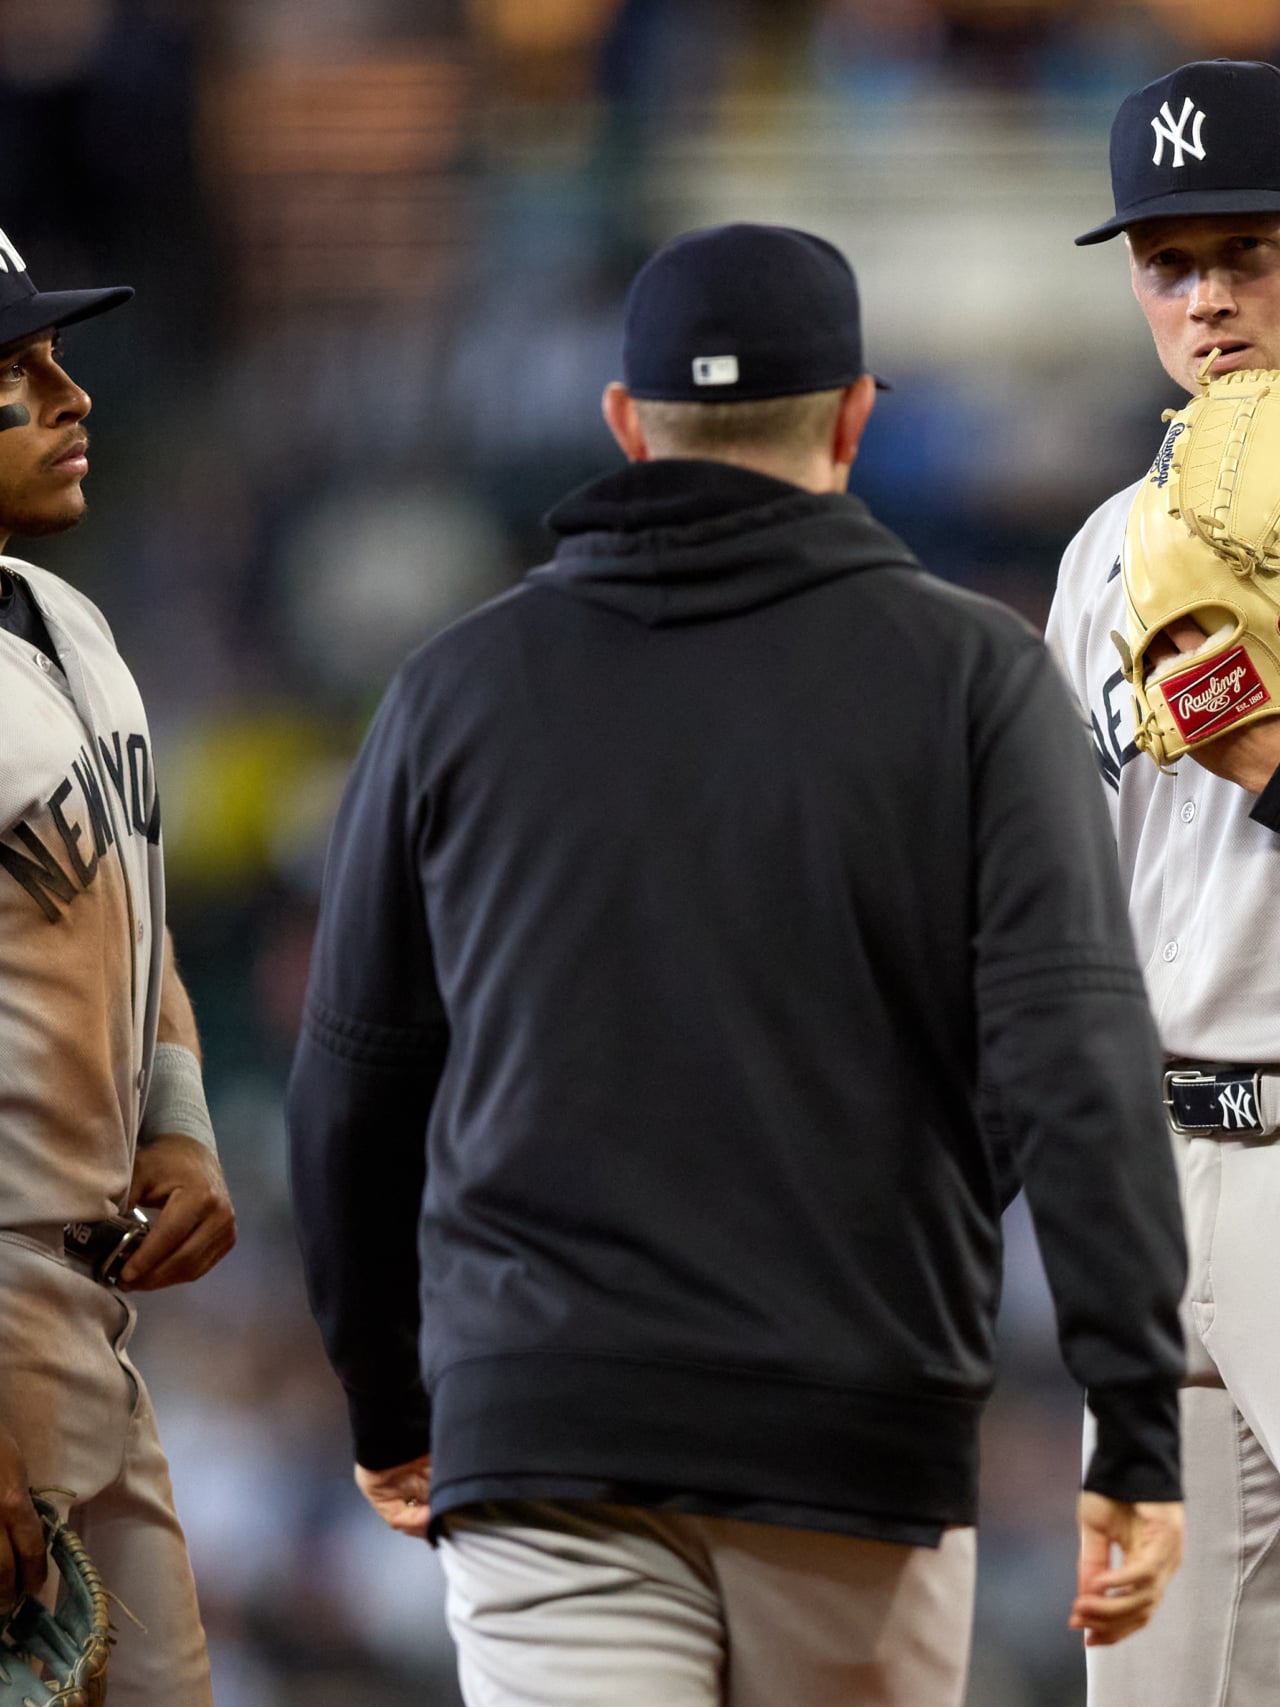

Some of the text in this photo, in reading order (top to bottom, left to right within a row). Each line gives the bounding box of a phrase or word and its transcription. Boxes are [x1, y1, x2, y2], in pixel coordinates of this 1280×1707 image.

[1151, 97, 1206, 168] NY
[1179, 666, 1247, 719] Rawlings
[1217, 1083, 1257, 1130] NY
